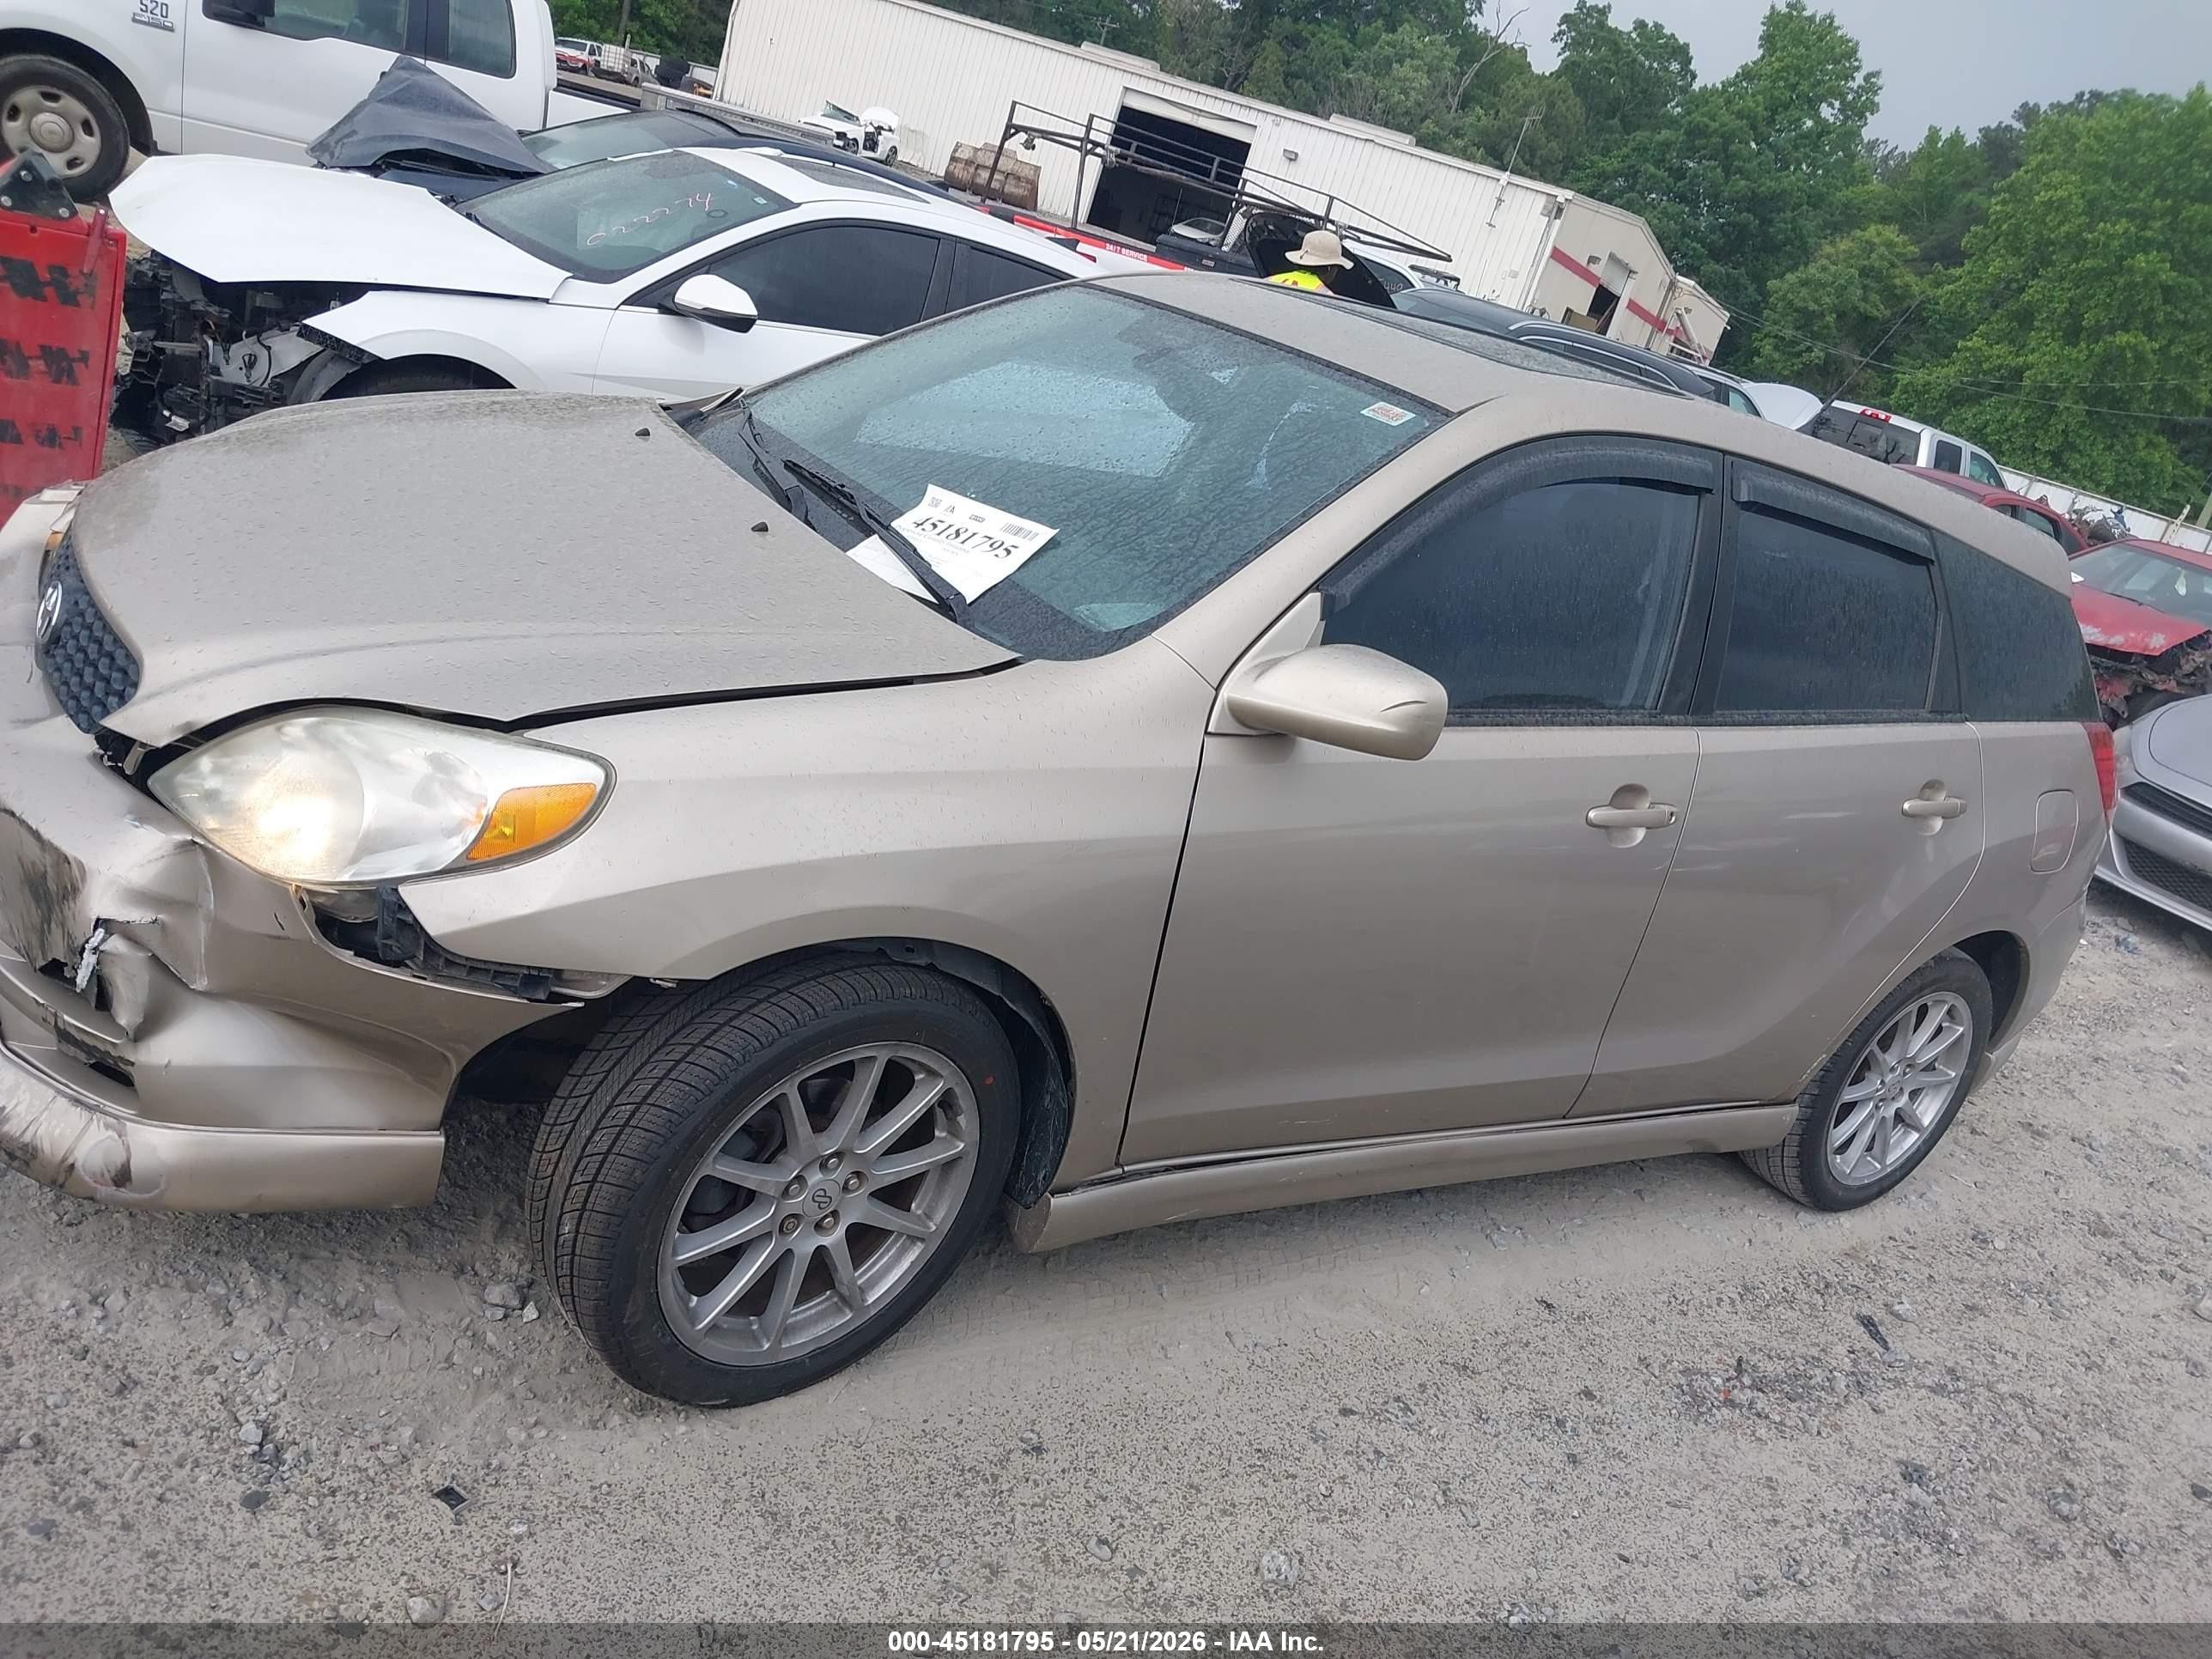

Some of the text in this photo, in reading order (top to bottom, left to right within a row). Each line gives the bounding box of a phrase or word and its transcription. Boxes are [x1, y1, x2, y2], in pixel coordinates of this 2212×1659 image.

[139, 0, 168, 18] 520
[1121, 248, 1148, 262] SERVICE
[912, 516, 1019, 559] 45181795
